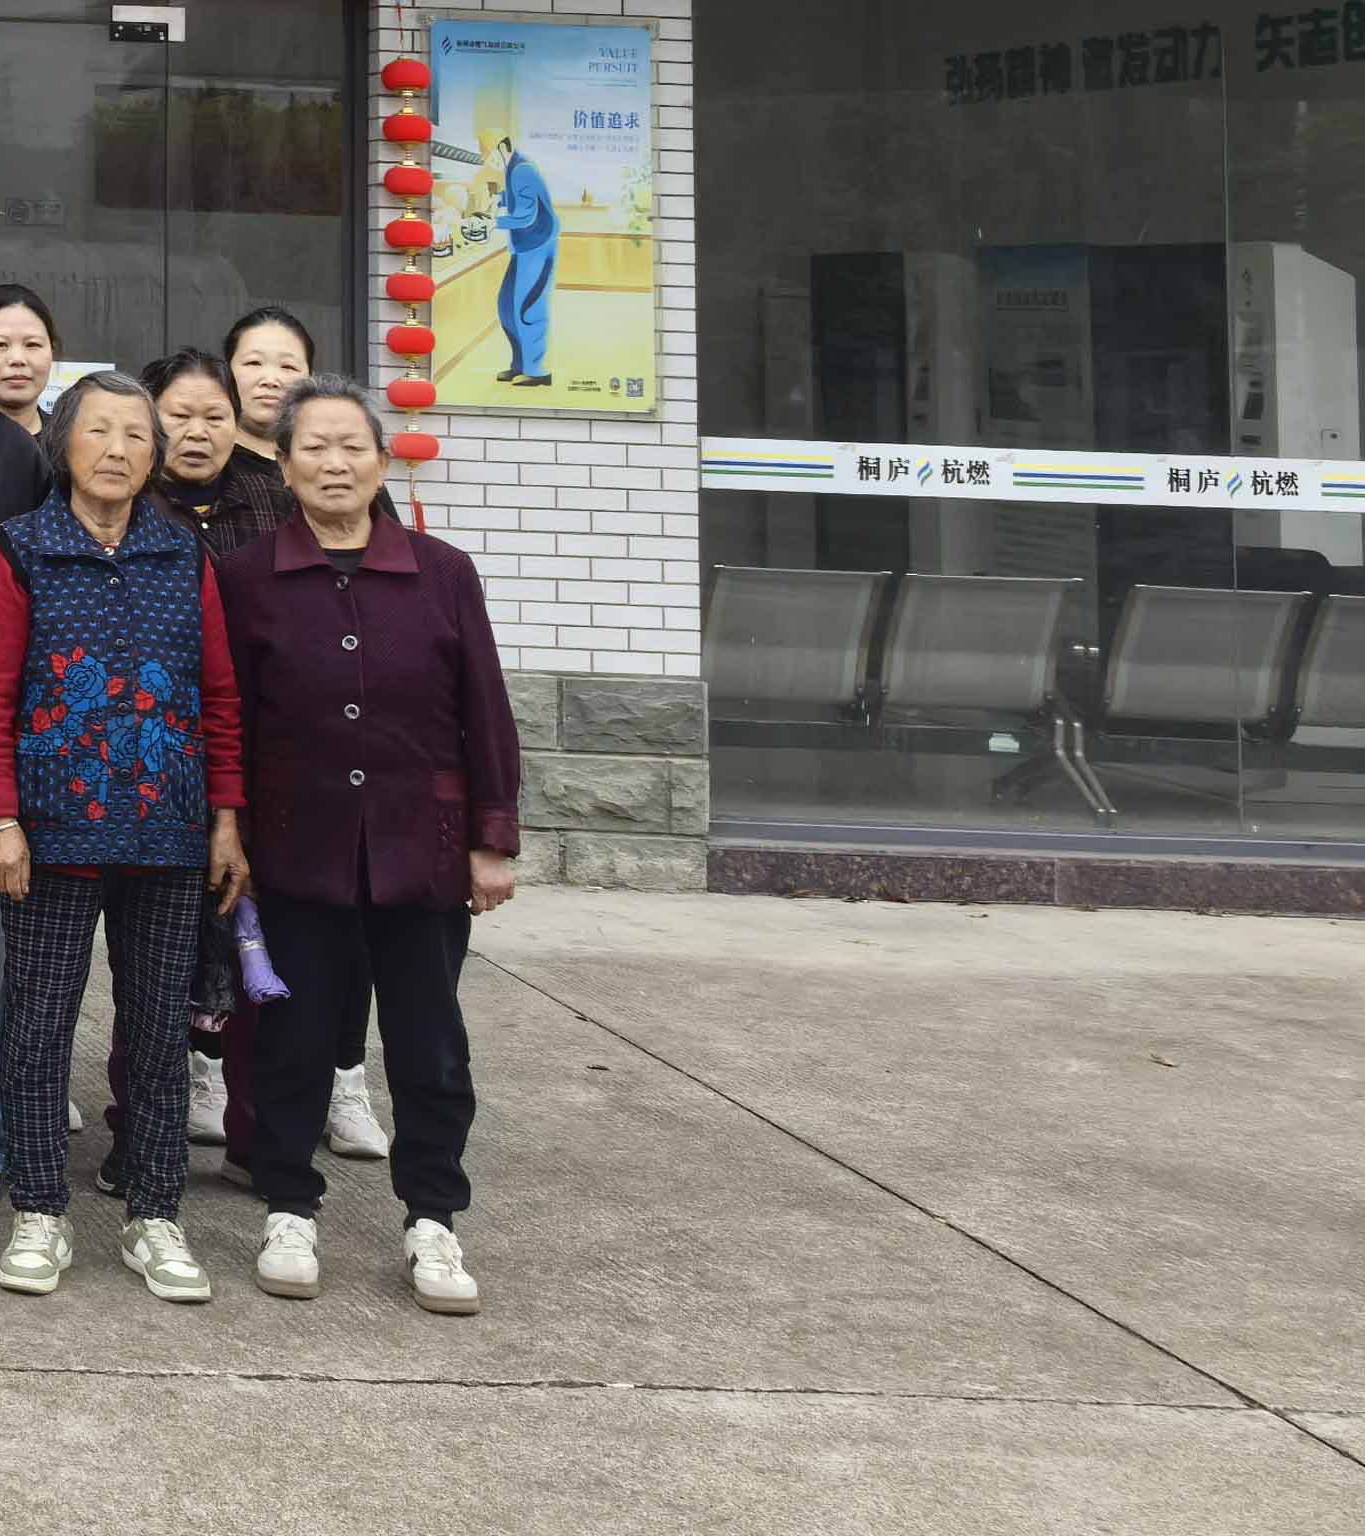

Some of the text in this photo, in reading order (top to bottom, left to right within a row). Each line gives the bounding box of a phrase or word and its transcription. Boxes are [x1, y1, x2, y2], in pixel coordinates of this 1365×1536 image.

[598, 47, 638, 58] VALUE
[588, 62, 638, 73] PURSUIT
[573, 109, 640, 129] 价值追求
